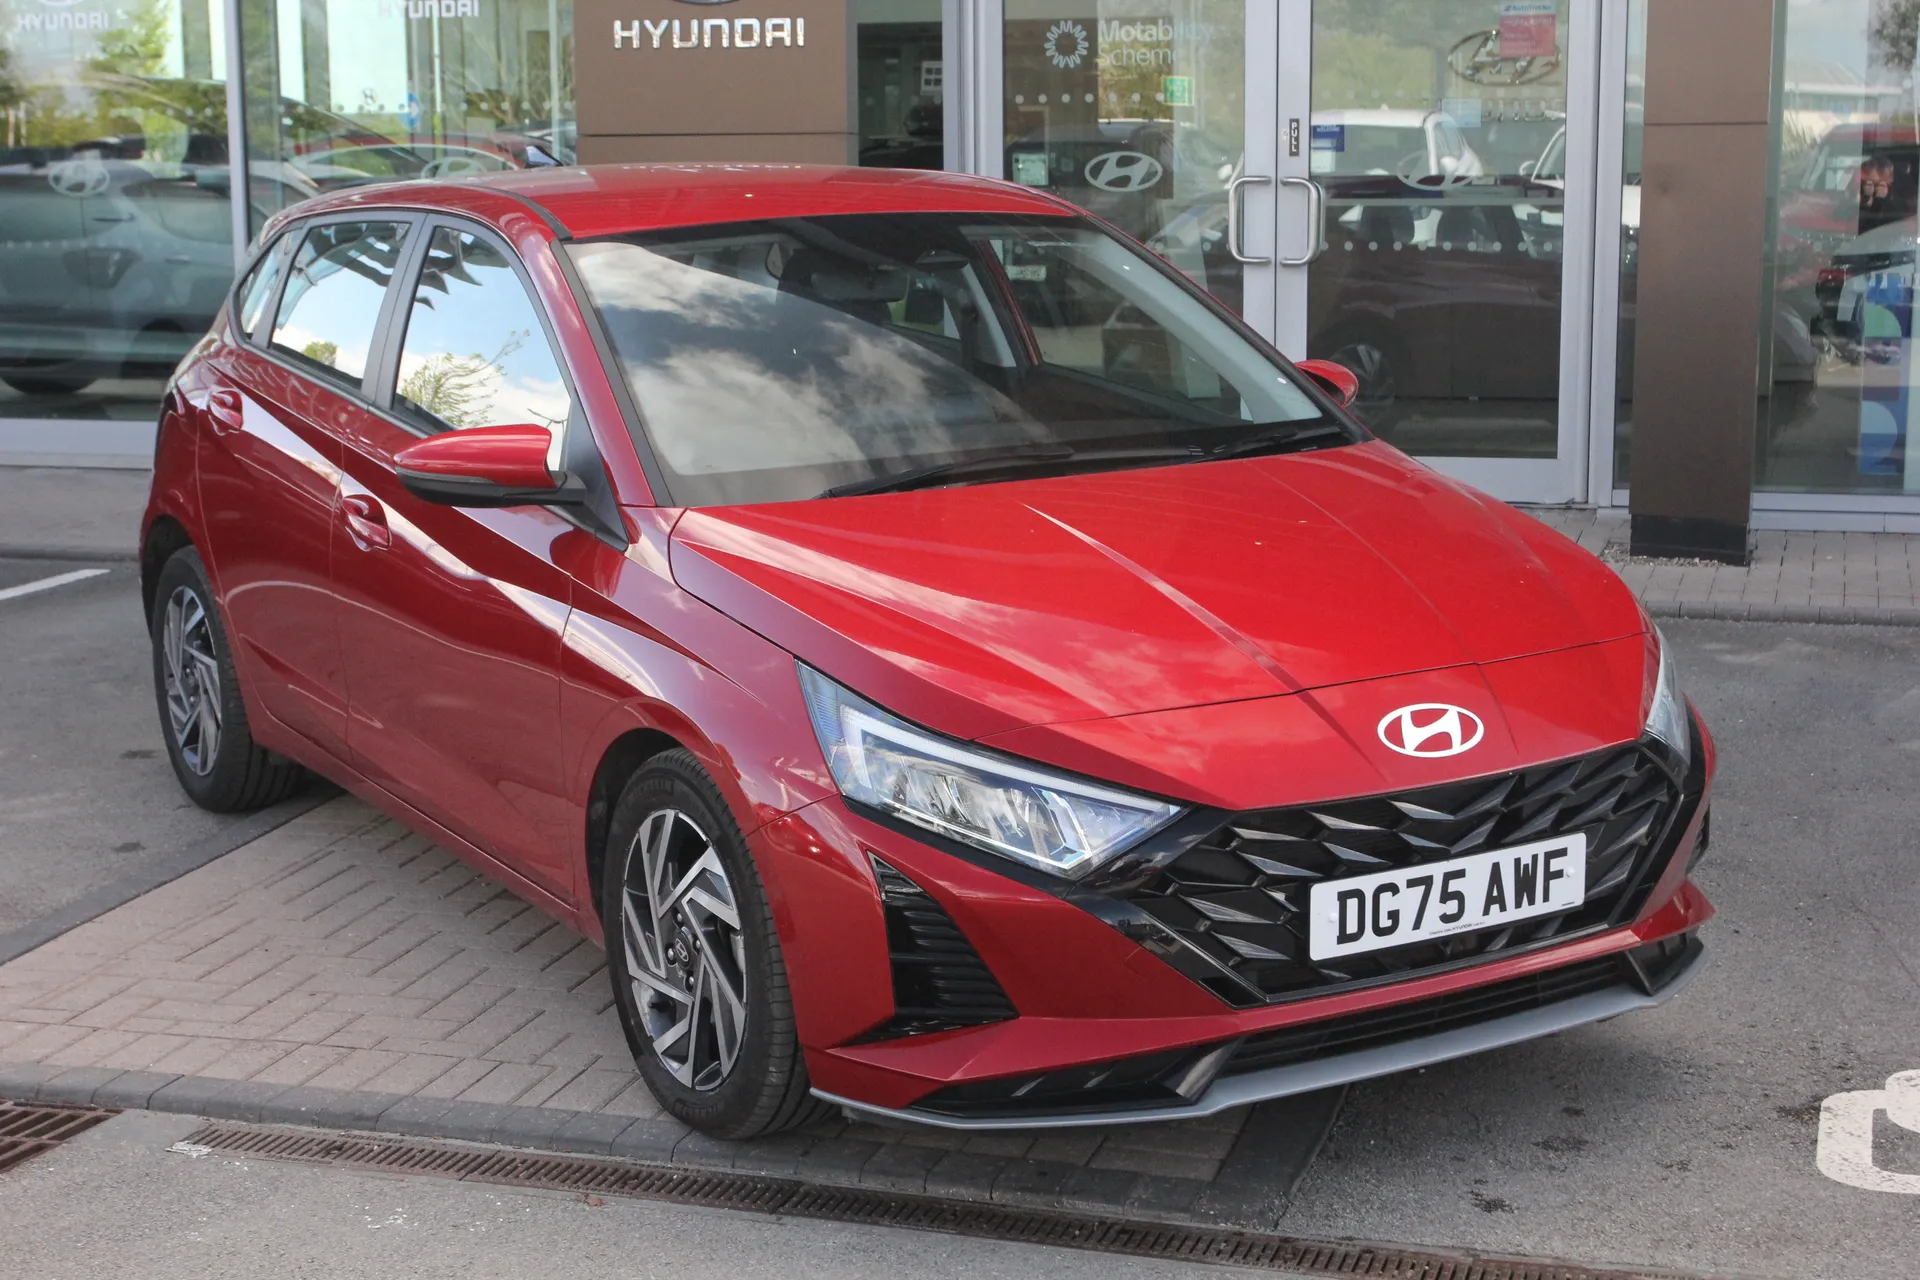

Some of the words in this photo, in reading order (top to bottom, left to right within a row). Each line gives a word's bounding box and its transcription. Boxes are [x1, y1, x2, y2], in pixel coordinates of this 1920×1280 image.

[16, 12, 110, 31] HYUNDAI
[613, 17, 805, 49] HYUNDAI
[1336, 868, 1467, 945] DG75
[1482, 846, 1569, 917] AWF
